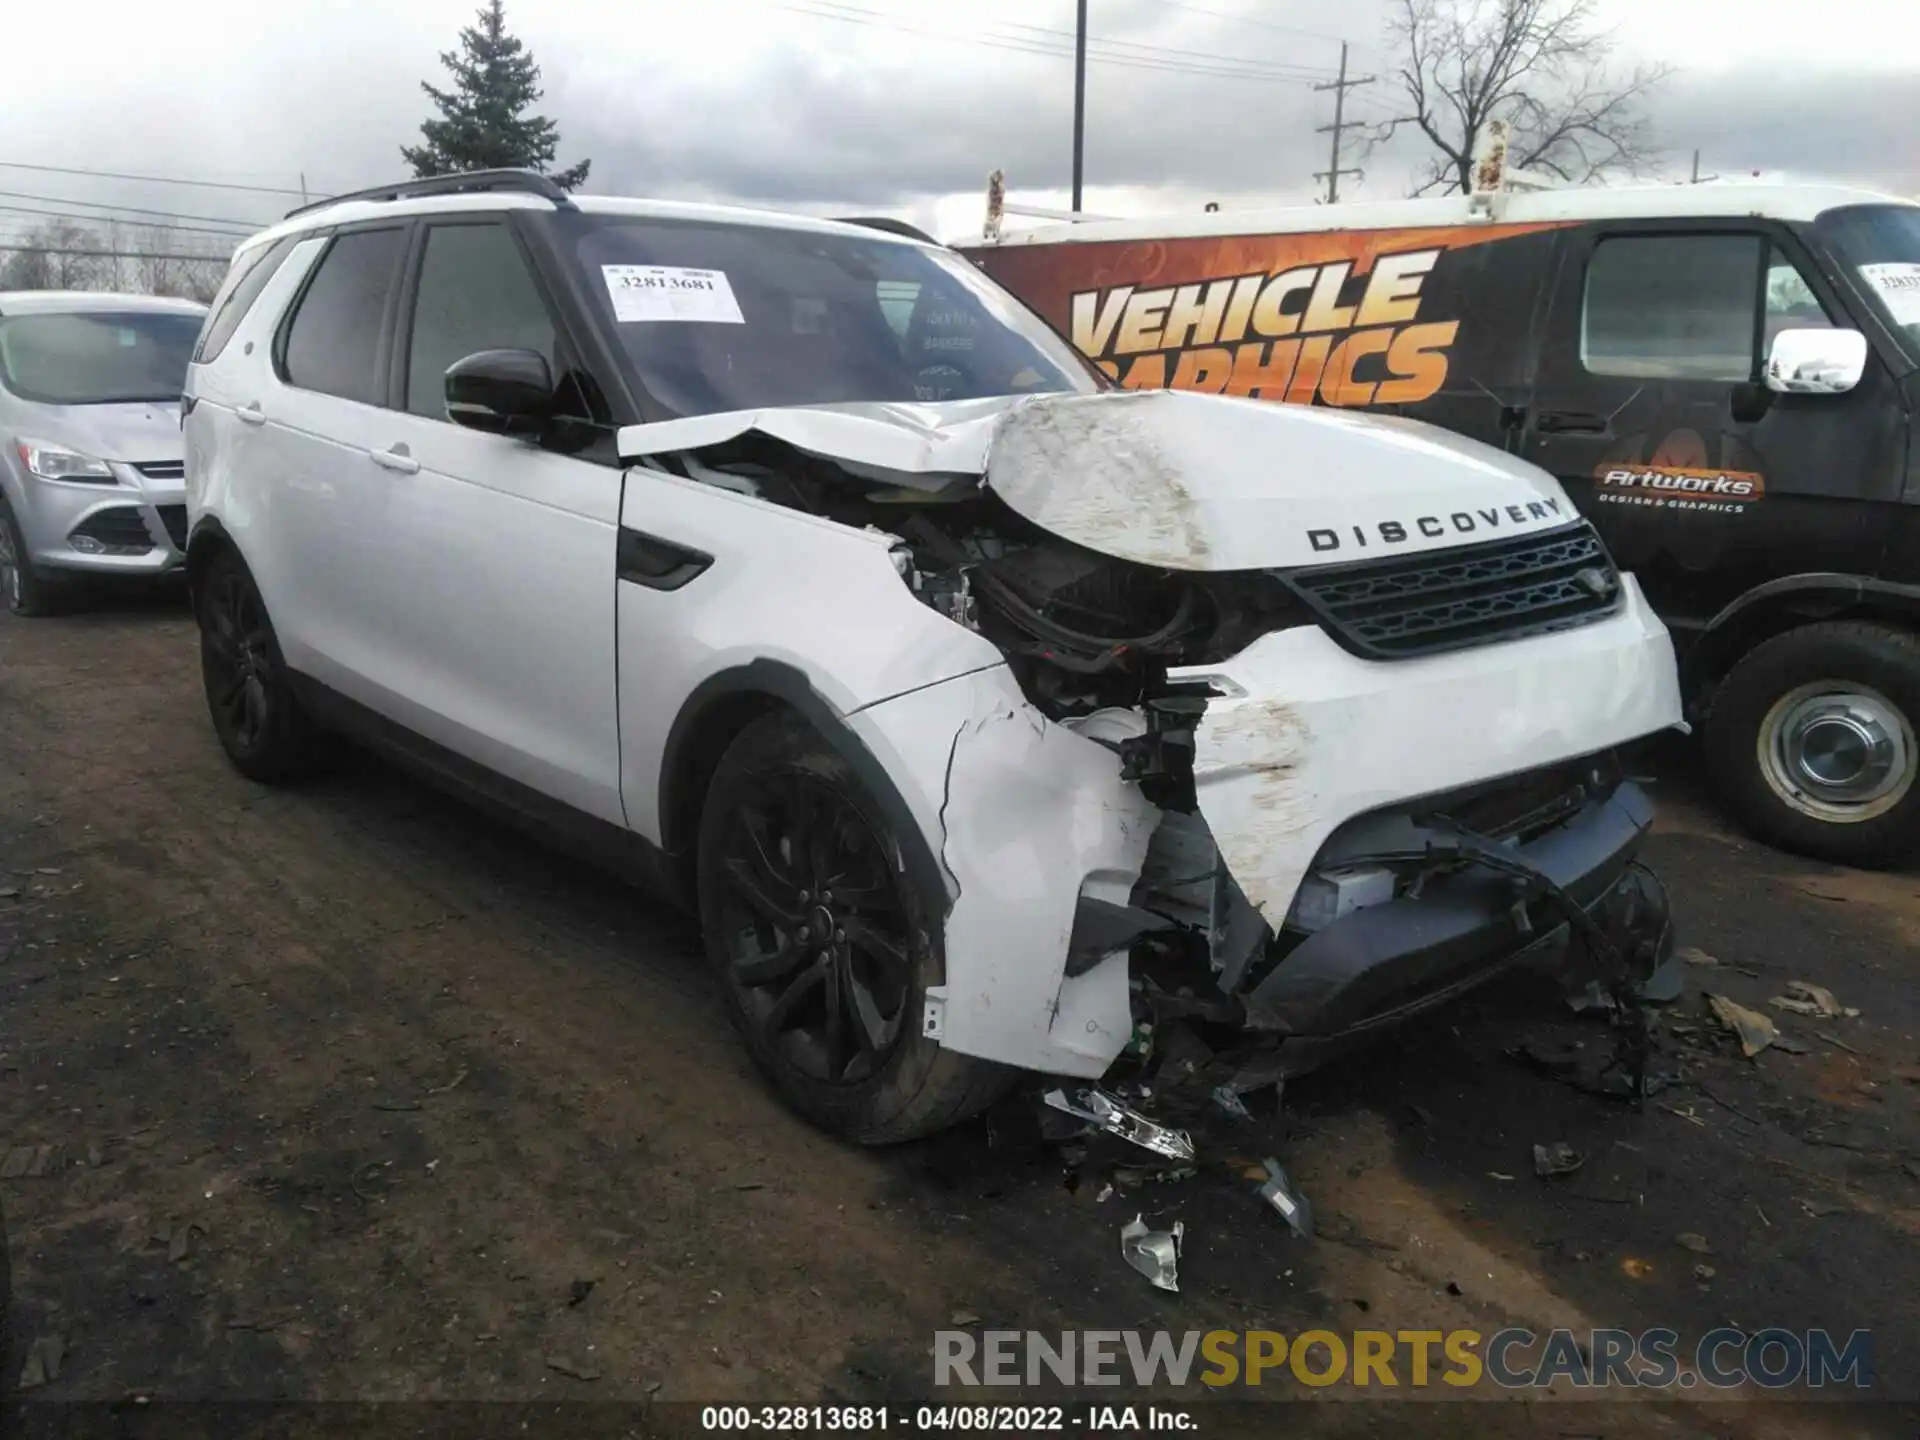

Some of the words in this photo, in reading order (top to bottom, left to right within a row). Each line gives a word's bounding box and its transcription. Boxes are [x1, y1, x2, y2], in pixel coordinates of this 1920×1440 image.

[620, 276, 714, 290] 32813681
[1072, 249, 1440, 357] VEHICLE
[1604, 471, 1753, 494] Artworks
[1599, 494, 1653, 505] DESIGN
[1668, 500, 1744, 513] GRAPHICS
[1306, 497, 1562, 551] DISCOVERY
